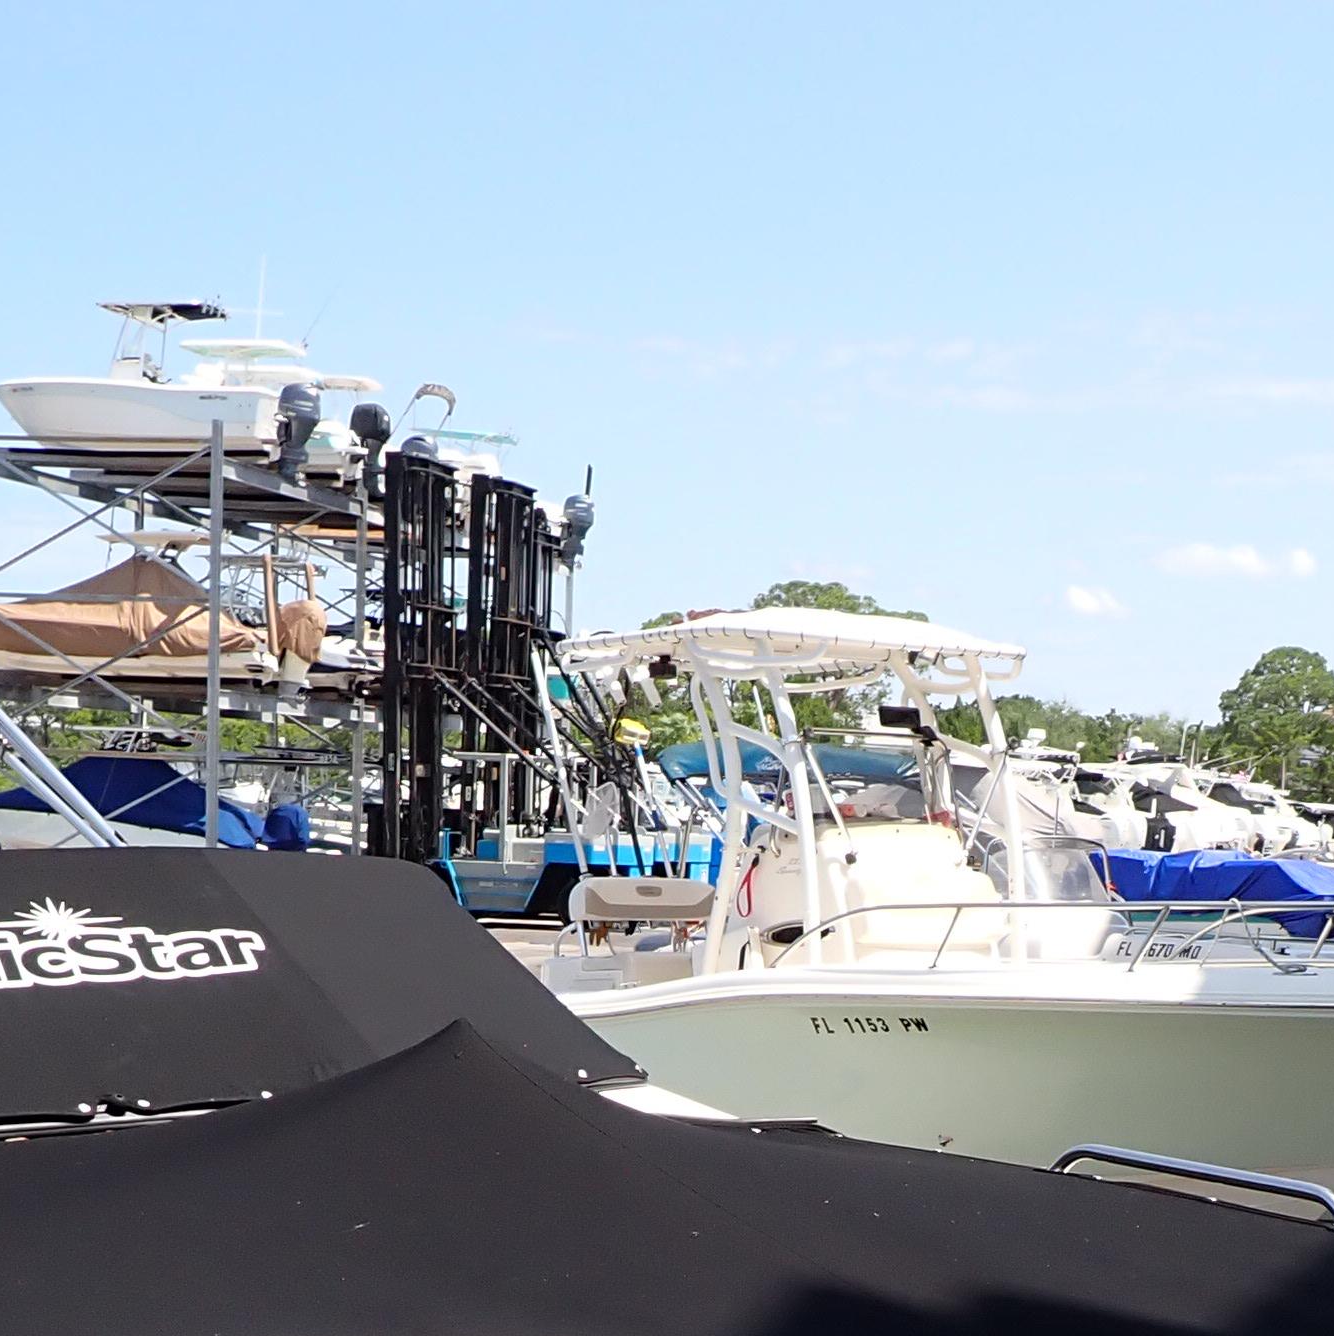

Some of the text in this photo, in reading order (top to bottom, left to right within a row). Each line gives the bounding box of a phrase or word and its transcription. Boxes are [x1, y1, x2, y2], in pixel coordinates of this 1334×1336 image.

[1116, 941, 1132, 957] FL
[1143, 942, 1174, 958] 670
[810, 1016, 929, 1034] FL 1153 PW
